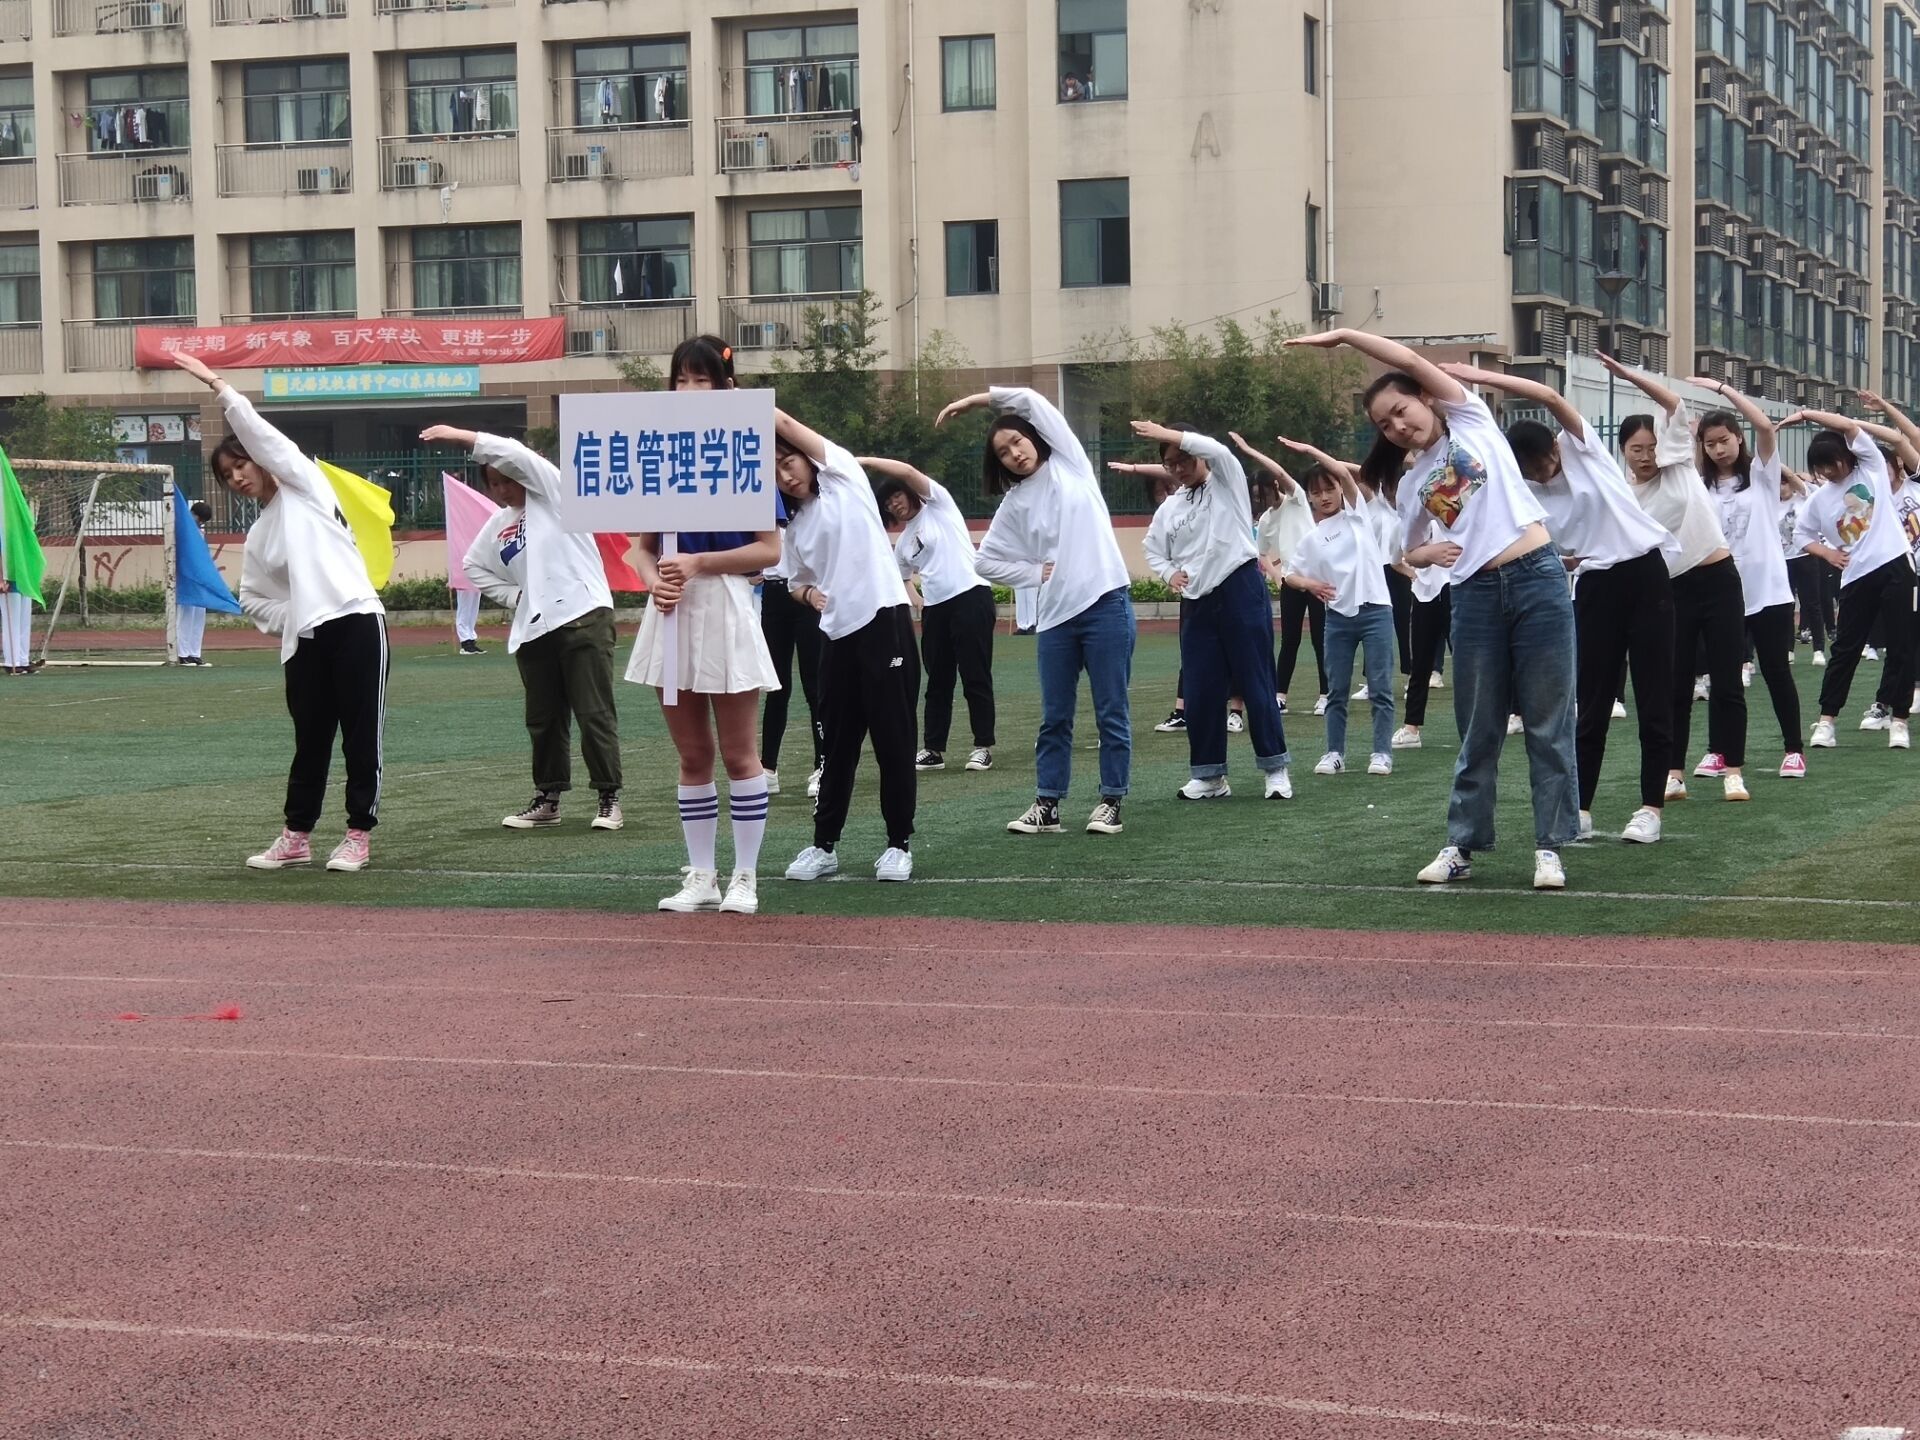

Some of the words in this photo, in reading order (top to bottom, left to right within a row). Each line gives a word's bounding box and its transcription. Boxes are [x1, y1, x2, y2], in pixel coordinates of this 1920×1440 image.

[159, 335, 226, 352] 新学期
[245, 329, 312, 349] 新气象
[331, 327, 421, 346] 百尺竿头
[440, 328, 532, 346] 更进一步
[573, 427, 762, 497] 信息管理学院
